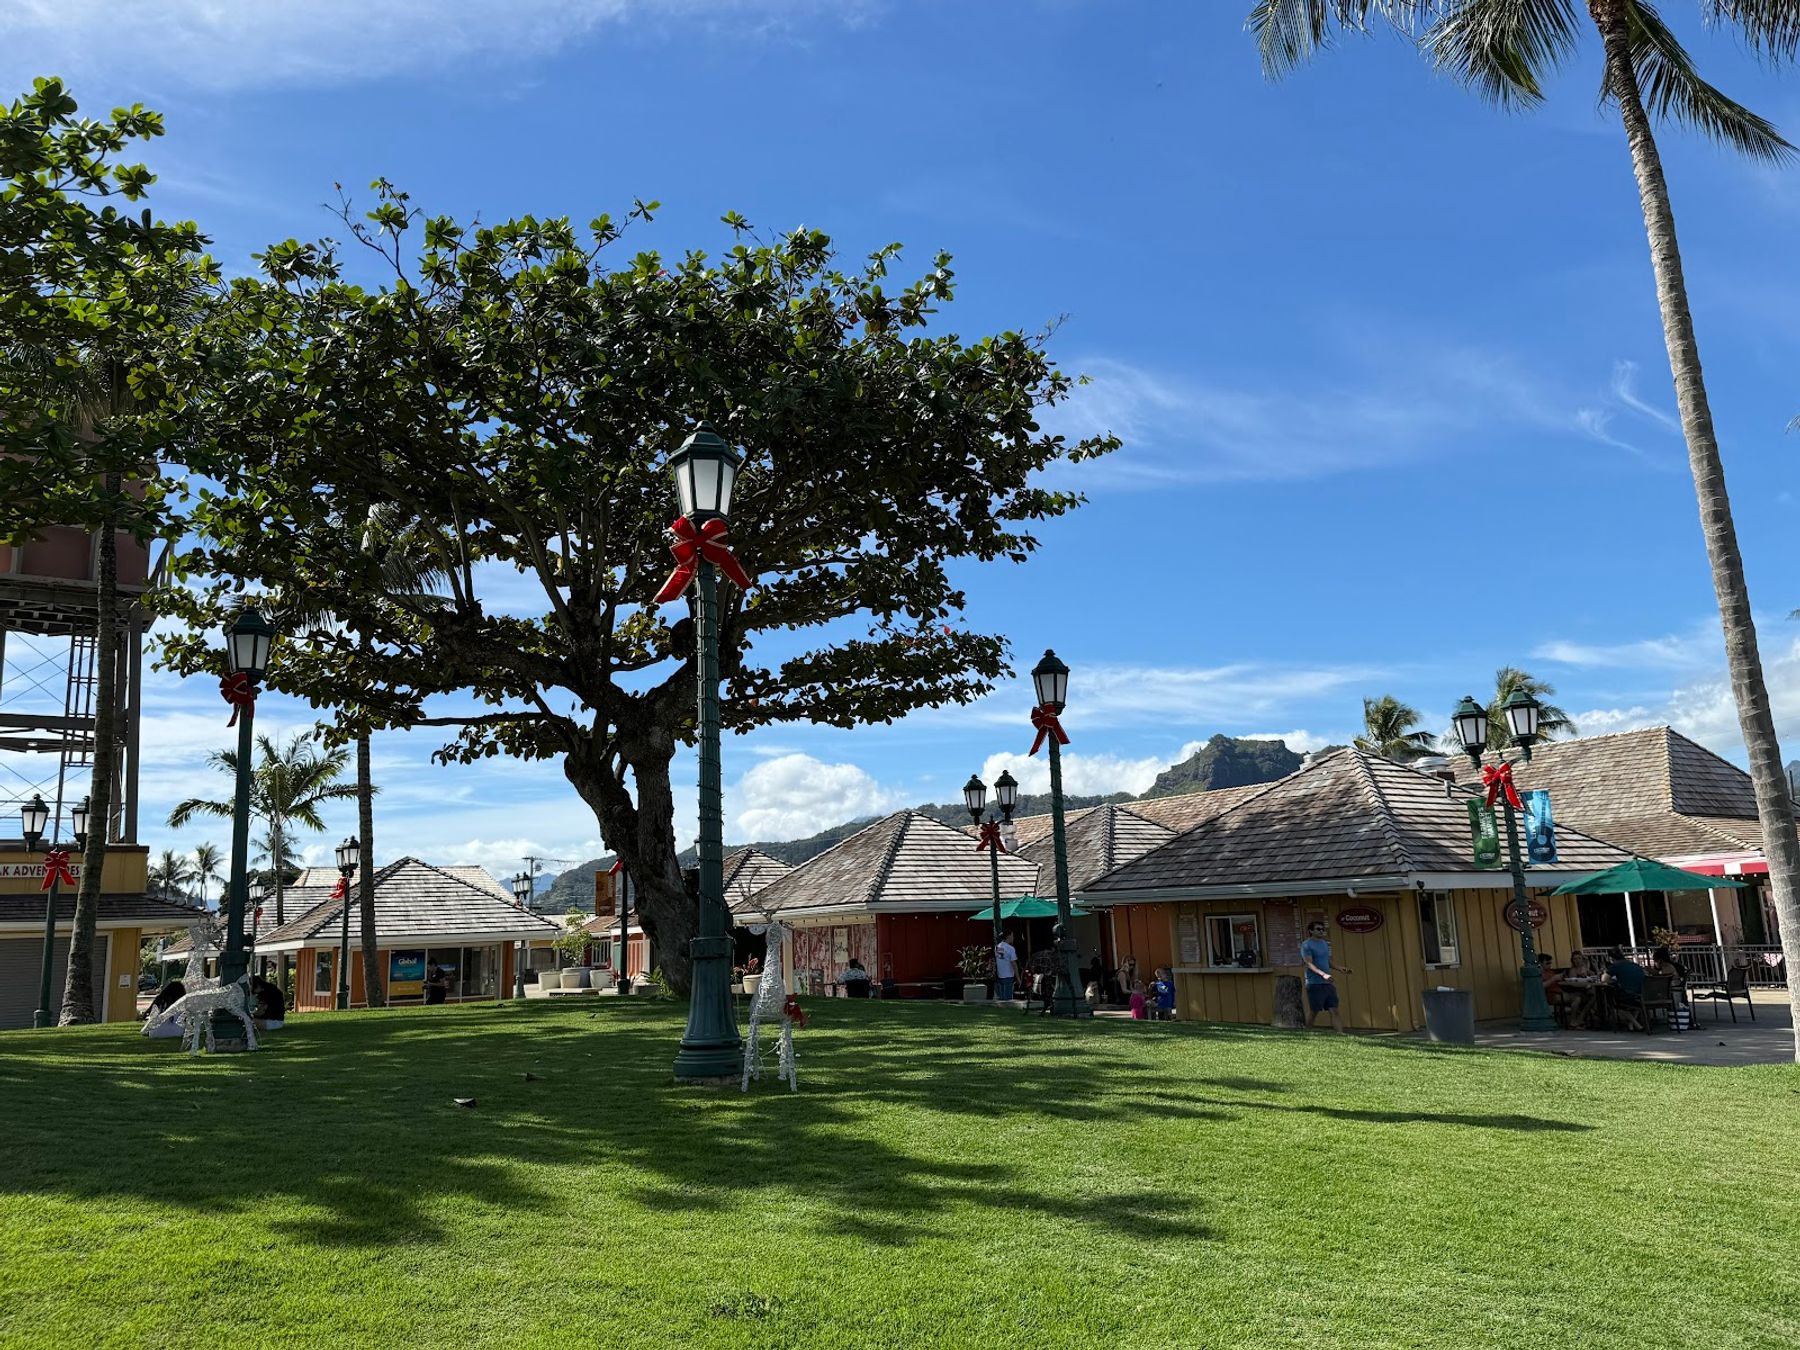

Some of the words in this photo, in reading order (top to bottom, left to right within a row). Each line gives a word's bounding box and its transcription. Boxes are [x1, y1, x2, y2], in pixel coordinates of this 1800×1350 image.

[1486, 812, 1495, 839] MARKET
[0, 866, 9, 876] K
[13, 865, 80, 876] ADVENES
[1345, 914, 1371, 922] Coconut
